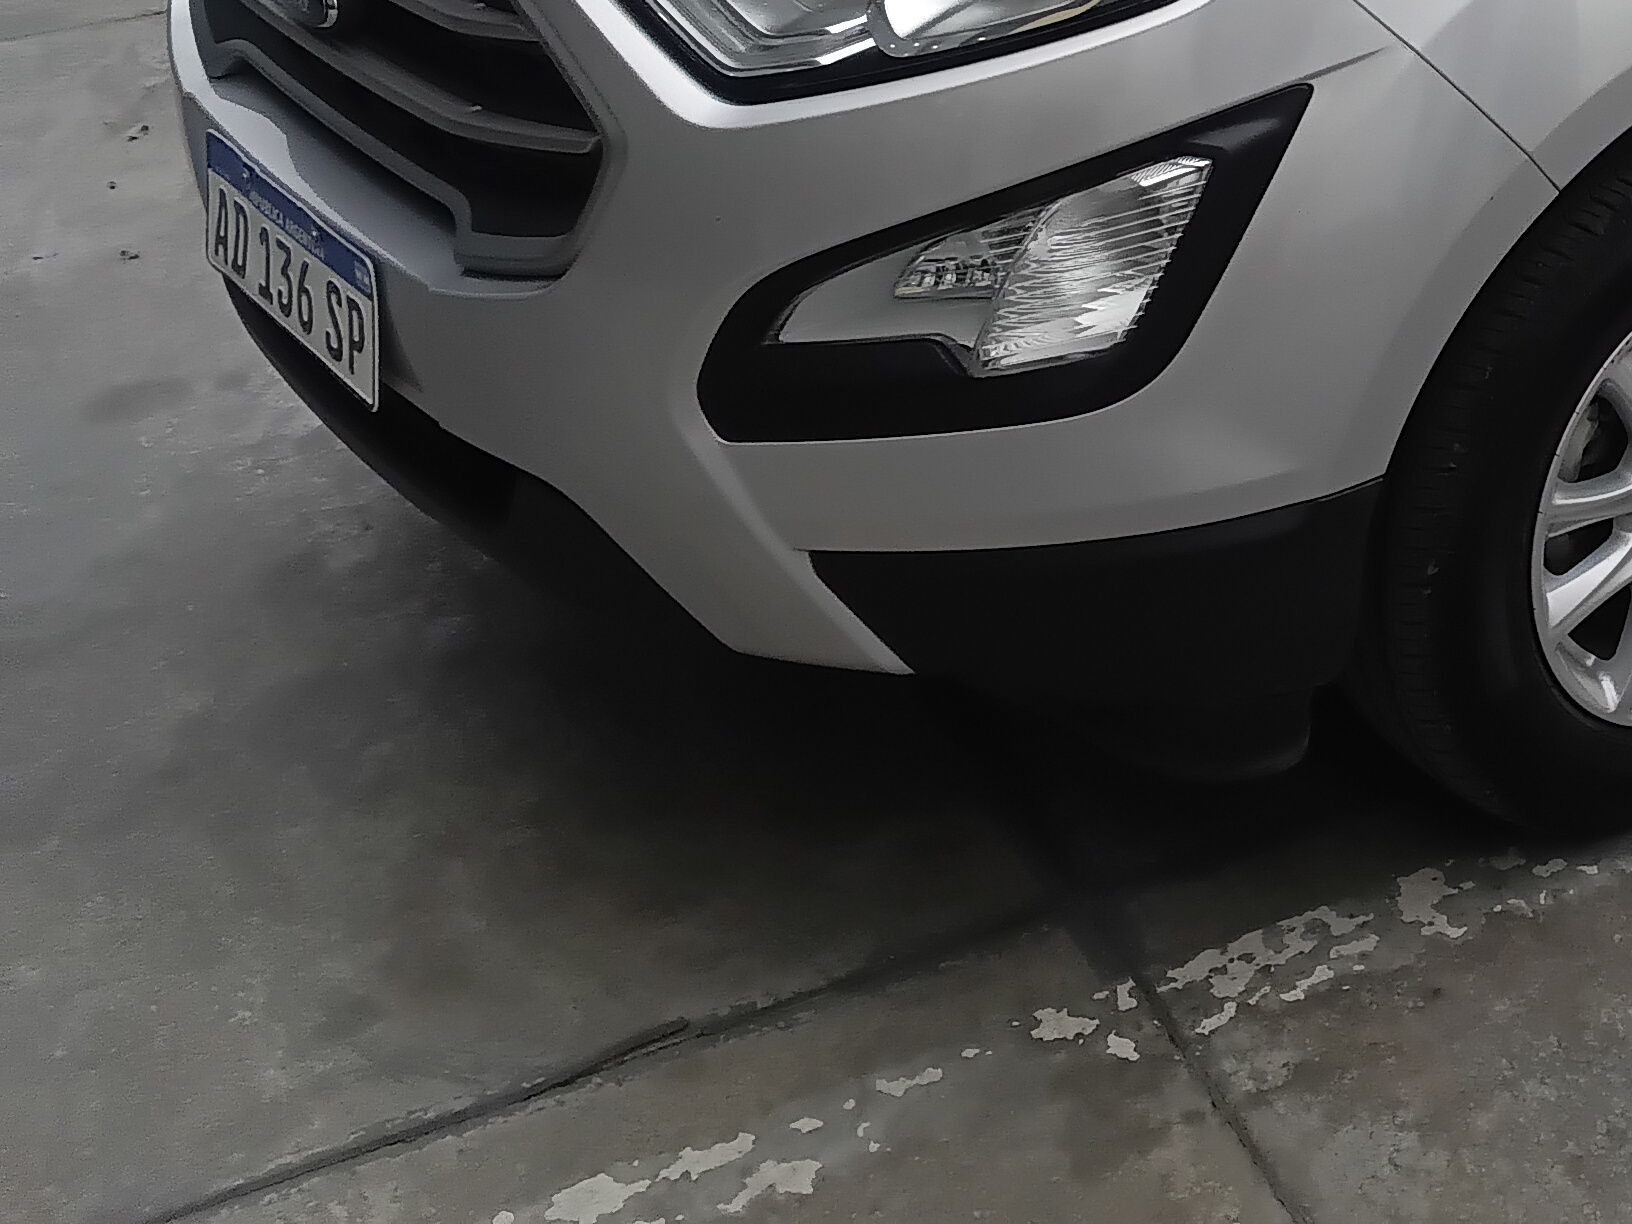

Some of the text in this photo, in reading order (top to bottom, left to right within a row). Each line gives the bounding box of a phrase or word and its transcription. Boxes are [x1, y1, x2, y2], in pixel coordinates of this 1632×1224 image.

[213, 185, 366, 376] AD 136 SP
